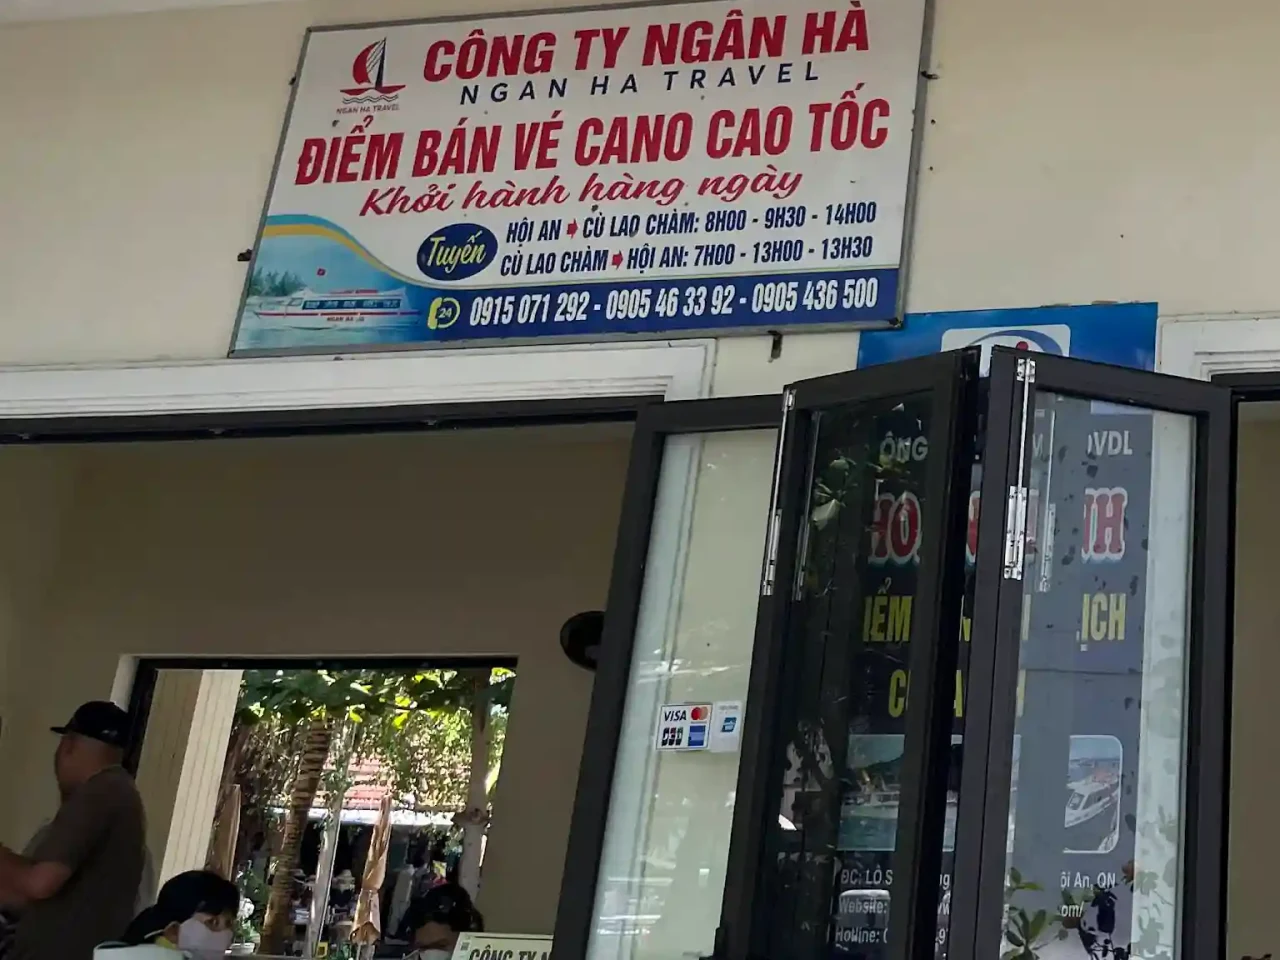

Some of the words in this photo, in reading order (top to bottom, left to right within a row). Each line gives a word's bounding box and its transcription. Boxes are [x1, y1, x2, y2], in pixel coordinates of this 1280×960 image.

[423, 28, 557, 82] CÔNG
[574, 26, 630, 71] TY
[642, 9, 787, 66] NGÂN
[801, 0, 869, 55] HÀ
[460, 77, 568, 105] NGAN
[590, 74, 638, 96] HA
[663, 61, 819, 91] TRAVEL
[294, 115, 405, 185] ĐIỂM
[411, 117, 502, 178] BÁN
[514, 110, 564, 171] VÉ
[574, 112, 693, 166] CANO
[706, 105, 793, 159] CAO
[808, 82, 890, 152] TỐC
[358, 183, 457, 217] Khởi
[461, 174, 571, 211] hành
[578, 172, 685, 206] hàng
[698, 164, 804, 203] ngày
[506, 216, 534, 247] HỘI
[539, 218, 562, 241] AN
[583, 212, 605, 239] CÙ
[609, 215, 639, 238] LAO
[646, 208, 699, 236] CHÀM:
[704, 209, 747, 233] 8H00
[764, 206, 806, 229] 9H30
[826, 201, 877, 225] 14H00
[425, 230, 487, 273] Tuyến
[500, 248, 522, 276] CÙ
[526, 251, 555, 275] LAO
[563, 243, 607, 273] CHÀM
[626, 244, 655, 274] HỘI
[659, 245, 689, 268] AN:
[694, 244, 735, 267] 7H00
[753, 239, 803, 264] 13H00
[822, 235, 873, 260] 13H30
[469, 294, 514, 326] 0915
[517, 293, 550, 324] 071
[554, 291, 590, 322] 292
[605, 289, 651, 320] 0905
[655, 287, 679, 318] 46
[682, 286, 706, 316] 33
[711, 284, 736, 315] 92
[751, 281, 799, 313] 0905
[802, 279, 837, 311] 436
[843, 277, 879, 308] 500
[664, 710, 687, 722] VISA
